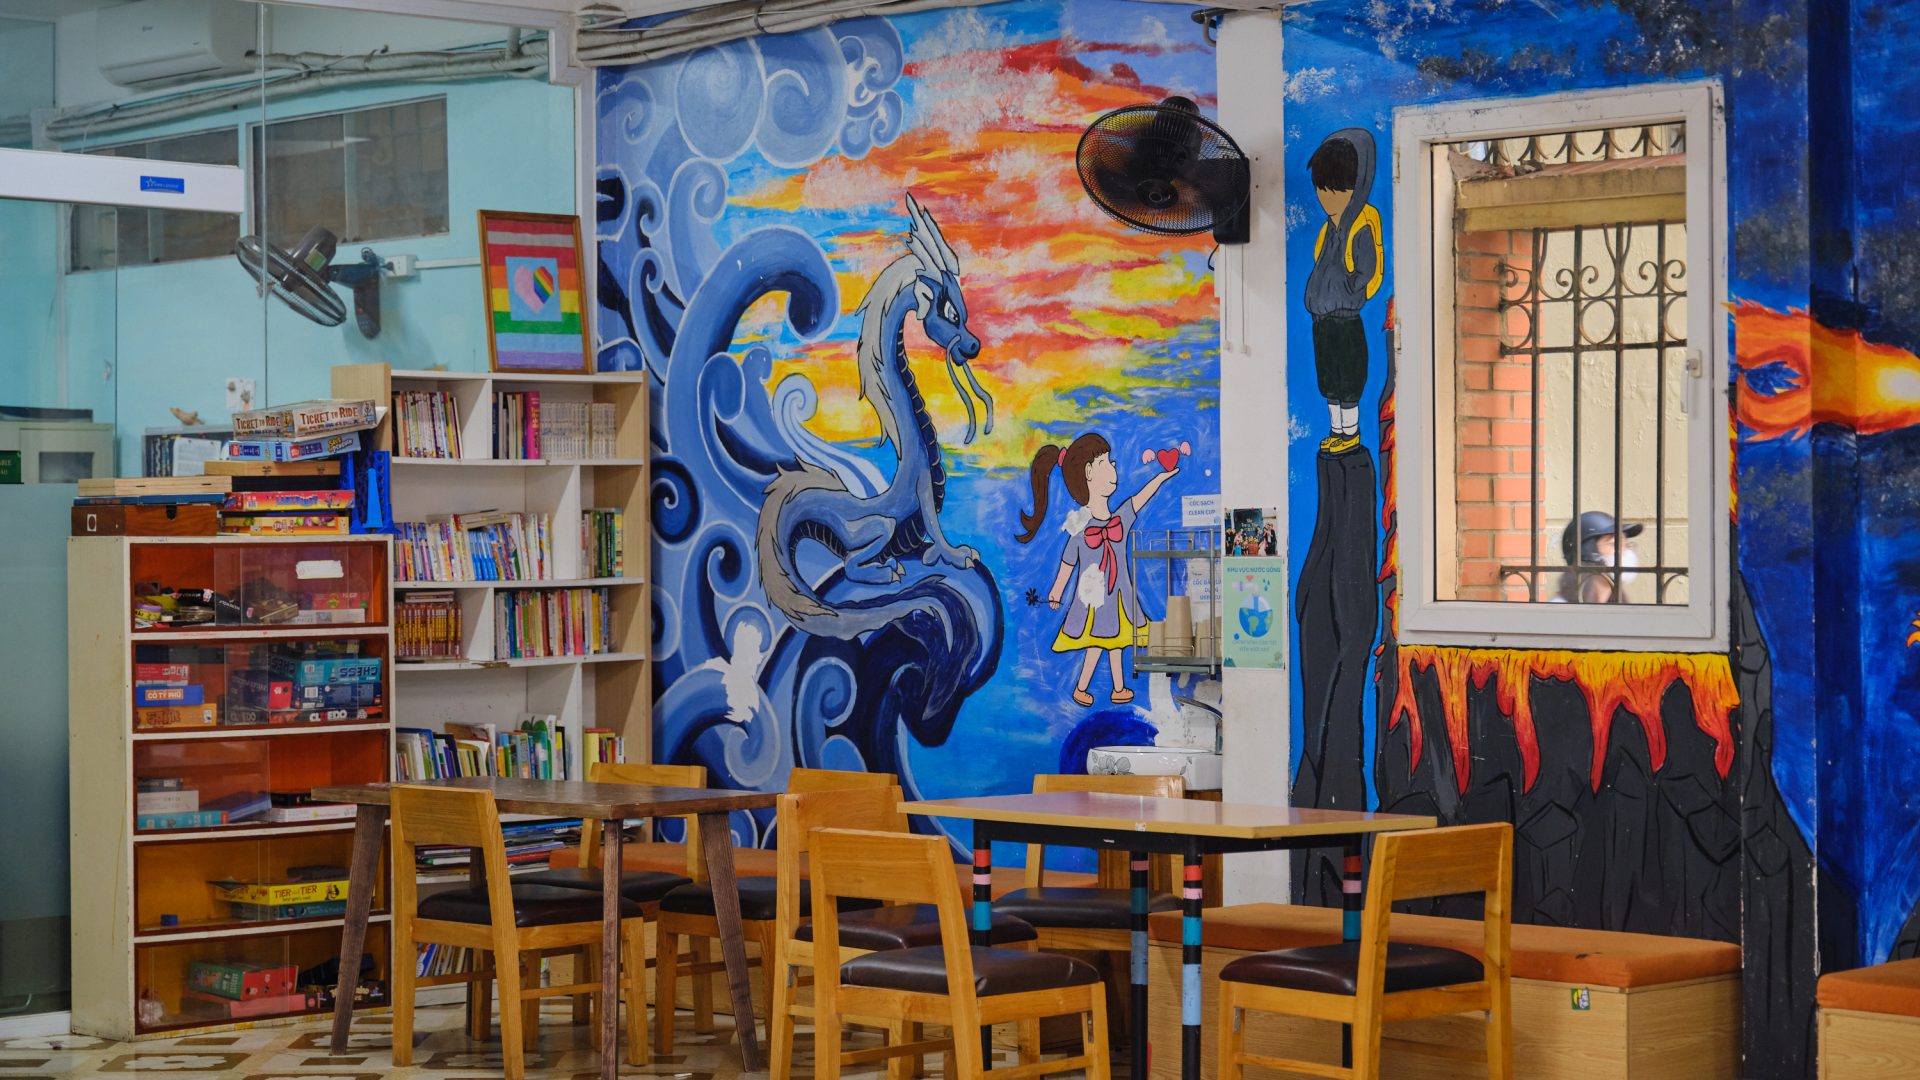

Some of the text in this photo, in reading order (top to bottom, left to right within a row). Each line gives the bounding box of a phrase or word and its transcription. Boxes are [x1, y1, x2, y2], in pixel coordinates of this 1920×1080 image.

[236, 416, 259, 430] TICKET
[265, 415, 281, 427] RIDE
[300, 411, 330, 425] TICKET
[339, 406, 359, 418] RIDE
[340, 666, 378, 678] CHESS
[274, 888, 291, 898] TIER
[300, 885, 318, 895] TIER
